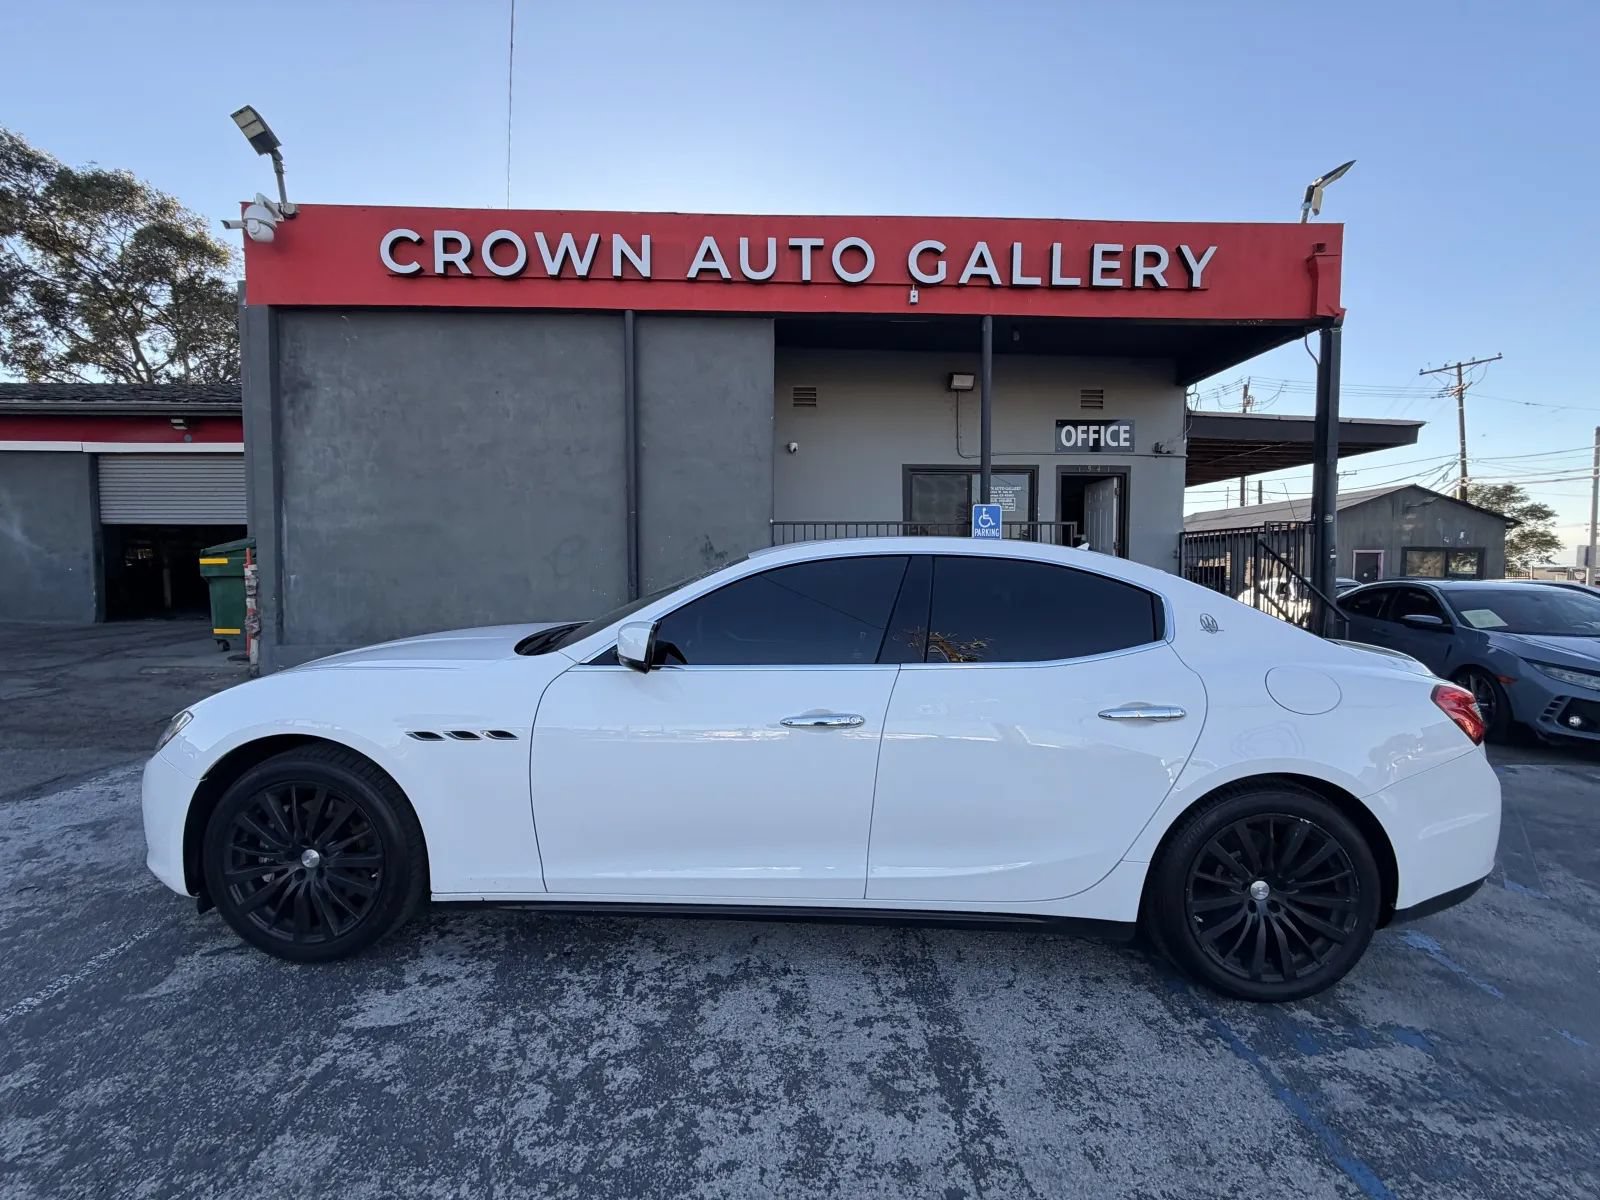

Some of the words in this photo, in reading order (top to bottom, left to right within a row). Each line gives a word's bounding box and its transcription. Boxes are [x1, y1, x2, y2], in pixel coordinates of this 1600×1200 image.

[379, 228, 651, 278] CROWN
[686, 235, 876, 283] AUTO
[908, 239, 1218, 289] GALLERY
[1060, 425, 1130, 447] OFFICE
[974, 528, 1000, 537] PARKING
